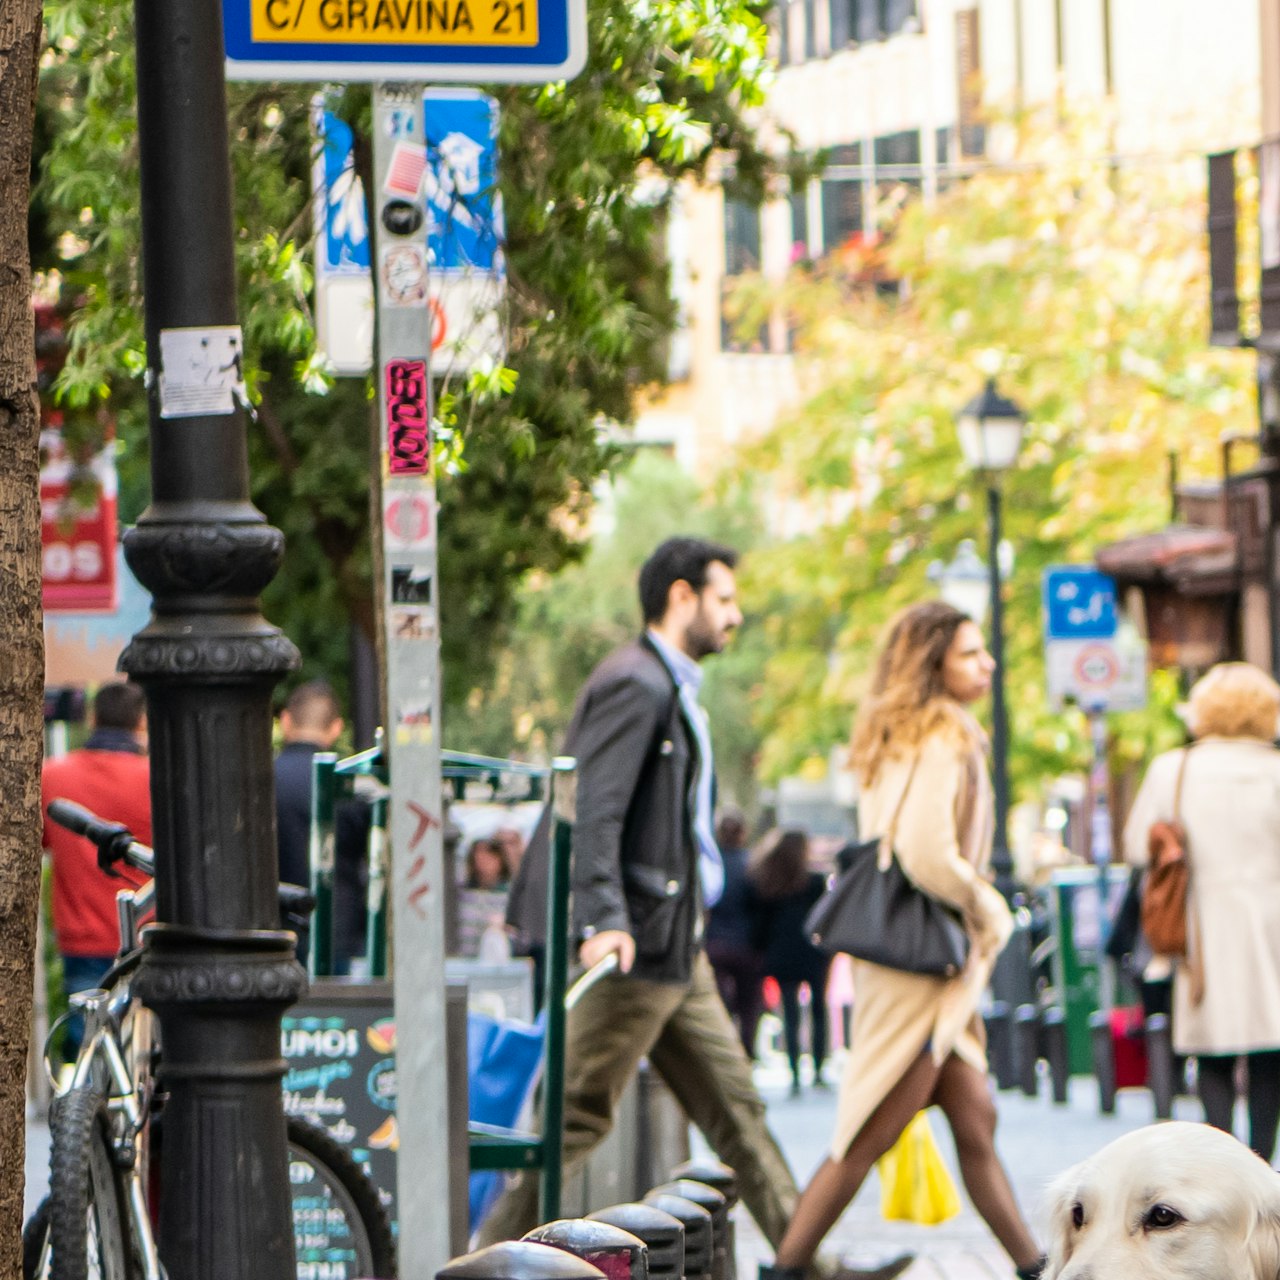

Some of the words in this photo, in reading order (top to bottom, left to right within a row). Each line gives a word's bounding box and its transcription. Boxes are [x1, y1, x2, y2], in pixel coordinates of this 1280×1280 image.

[265, 0, 303, 31] C/
[318, 0, 474, 33] GRAVINA
[491, 1, 526, 34] 21
[281, 1028, 358, 1057] UMOS
